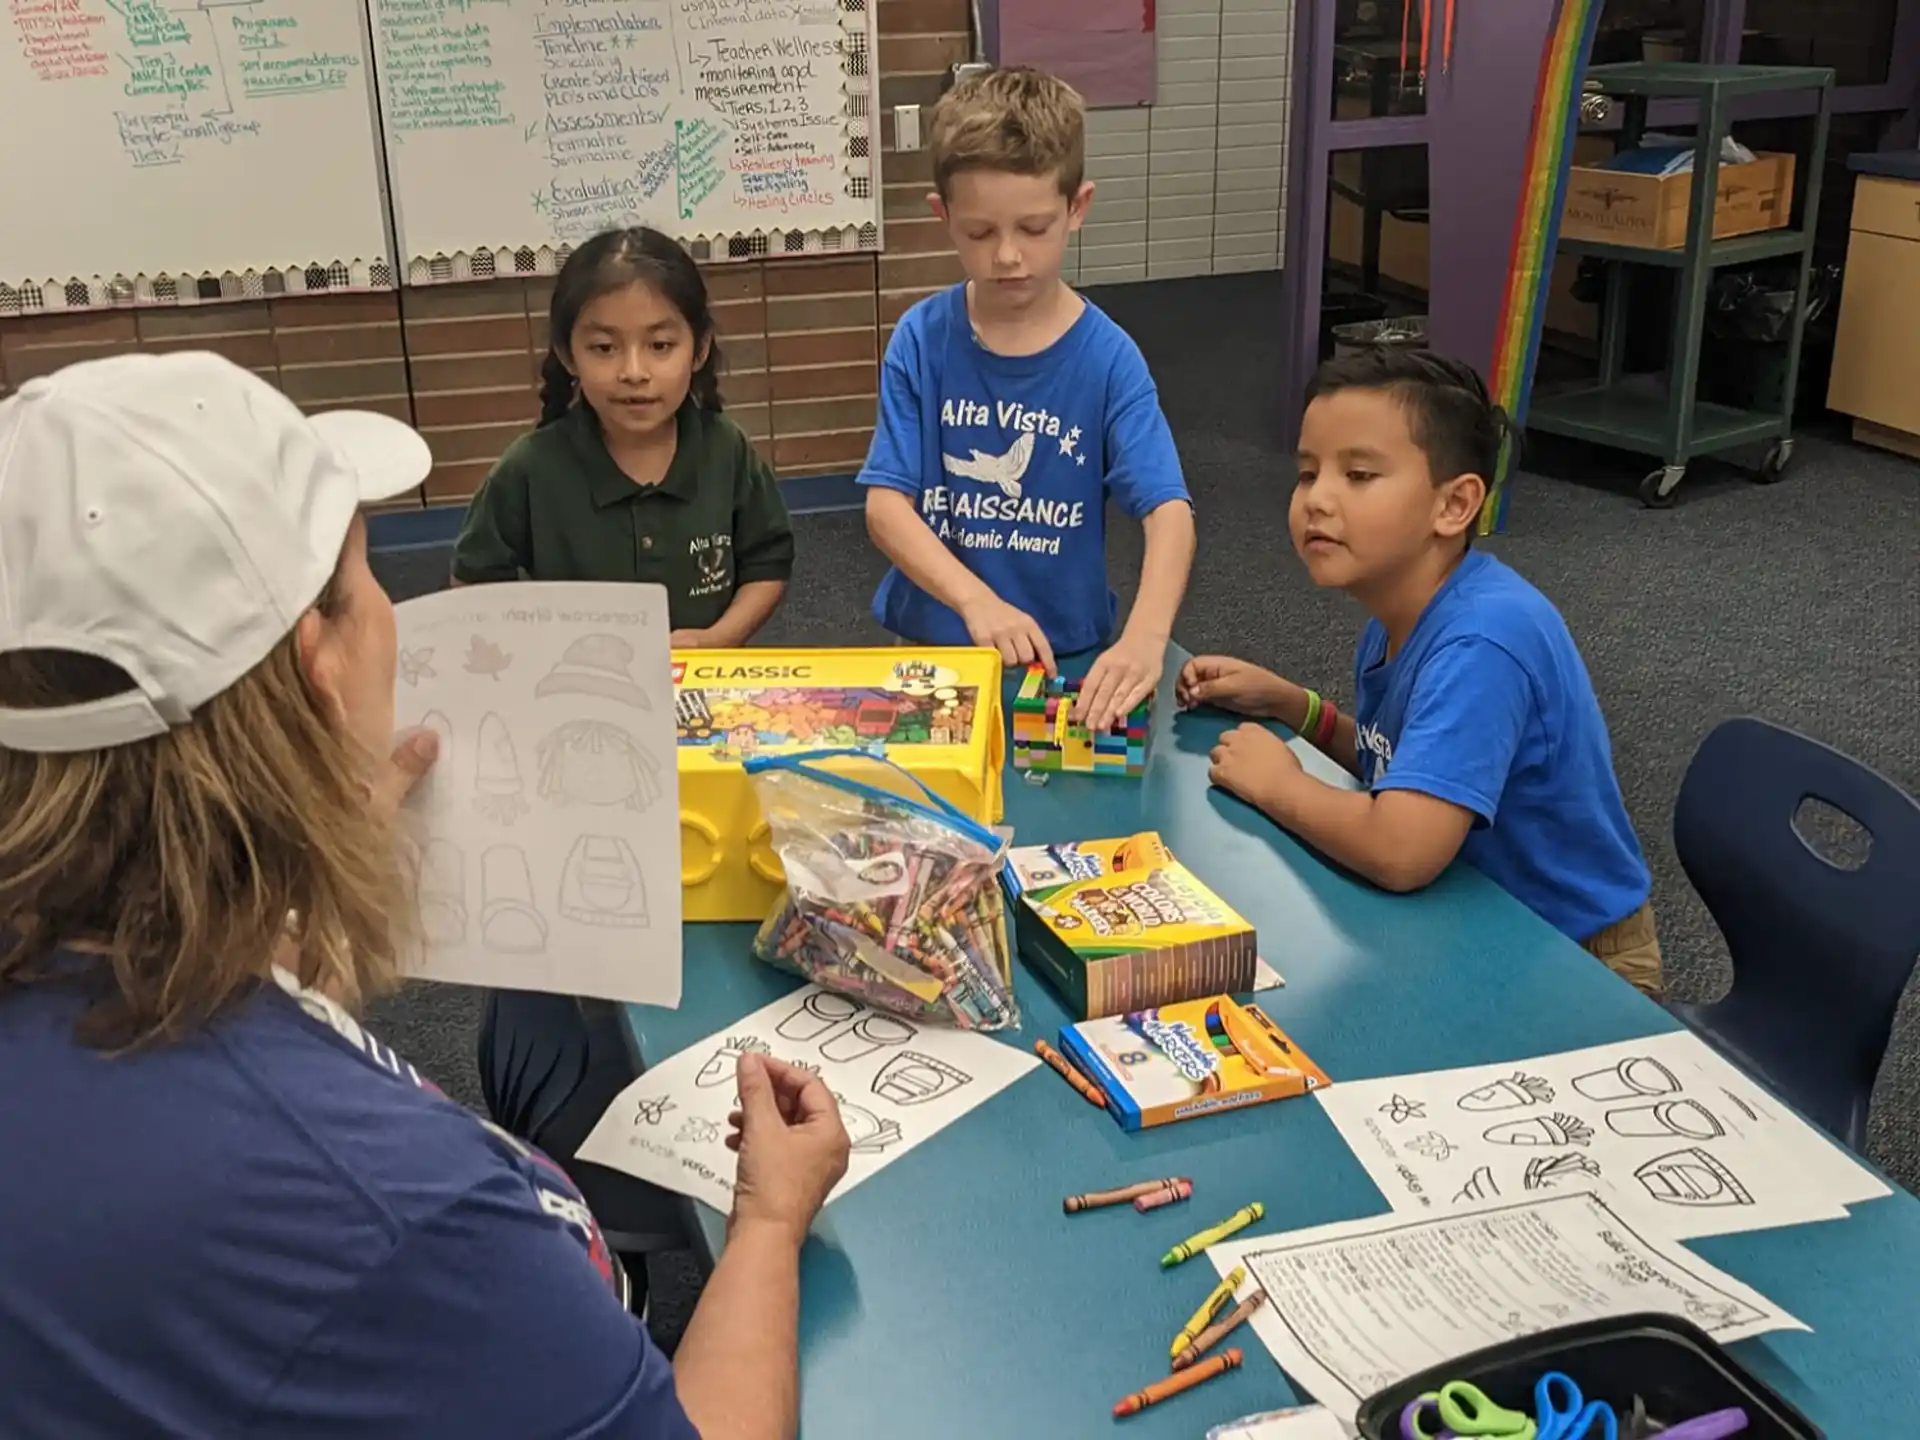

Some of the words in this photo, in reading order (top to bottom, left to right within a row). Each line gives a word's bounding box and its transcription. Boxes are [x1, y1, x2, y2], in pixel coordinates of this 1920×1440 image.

[772, 36, 842, 59] Wellness
[781, 60, 818, 86] and
[941, 399, 990, 427] Alta
[996, 400, 1061, 437] Vista
[1007, 529, 1061, 556] Award
[693, 665, 813, 680] CLASSIC
[1118, 1051, 1148, 1066] 8
